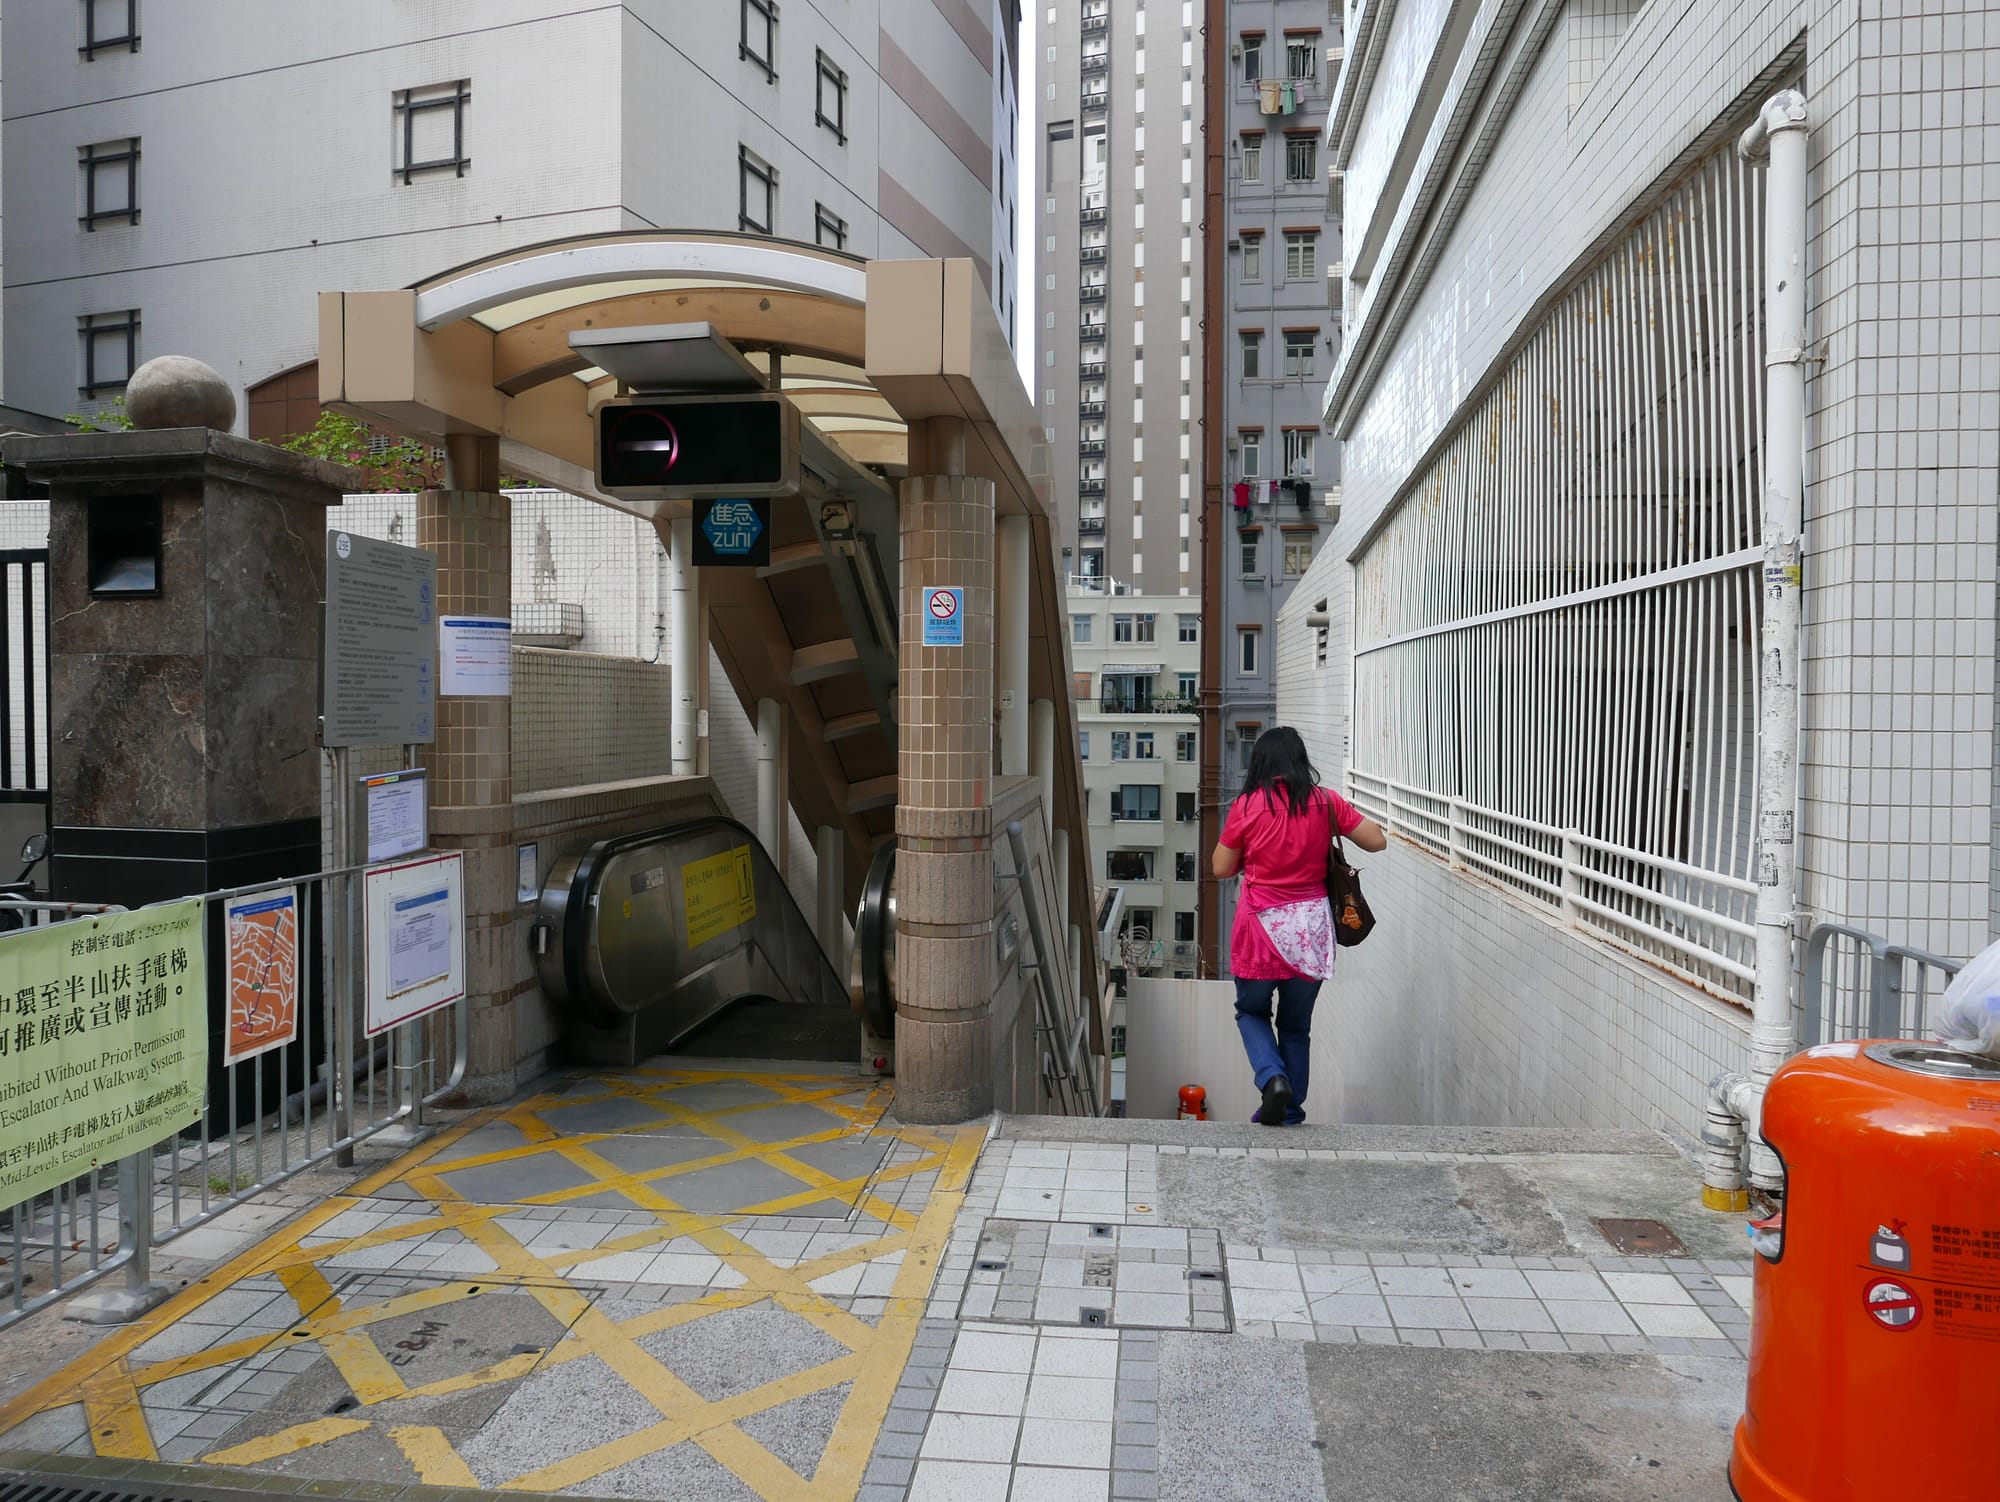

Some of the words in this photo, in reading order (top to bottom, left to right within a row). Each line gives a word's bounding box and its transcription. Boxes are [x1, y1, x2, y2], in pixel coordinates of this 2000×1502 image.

[44, 1058, 97, 1086] Without
[101, 1048, 133, 1068] Prior
[134, 1028, 185, 1057] Permission
[0, 1094, 60, 1129] Escalator
[62, 1081, 90, 1105] And
[93, 1065, 149, 1094] Walkway
[0, 1155, 59, 1190] Mid-Levels
[62, 1137, 105, 1163] Escalator
[106, 1128, 124, 1145] and
[127, 1115, 163, 1136] Walkway
